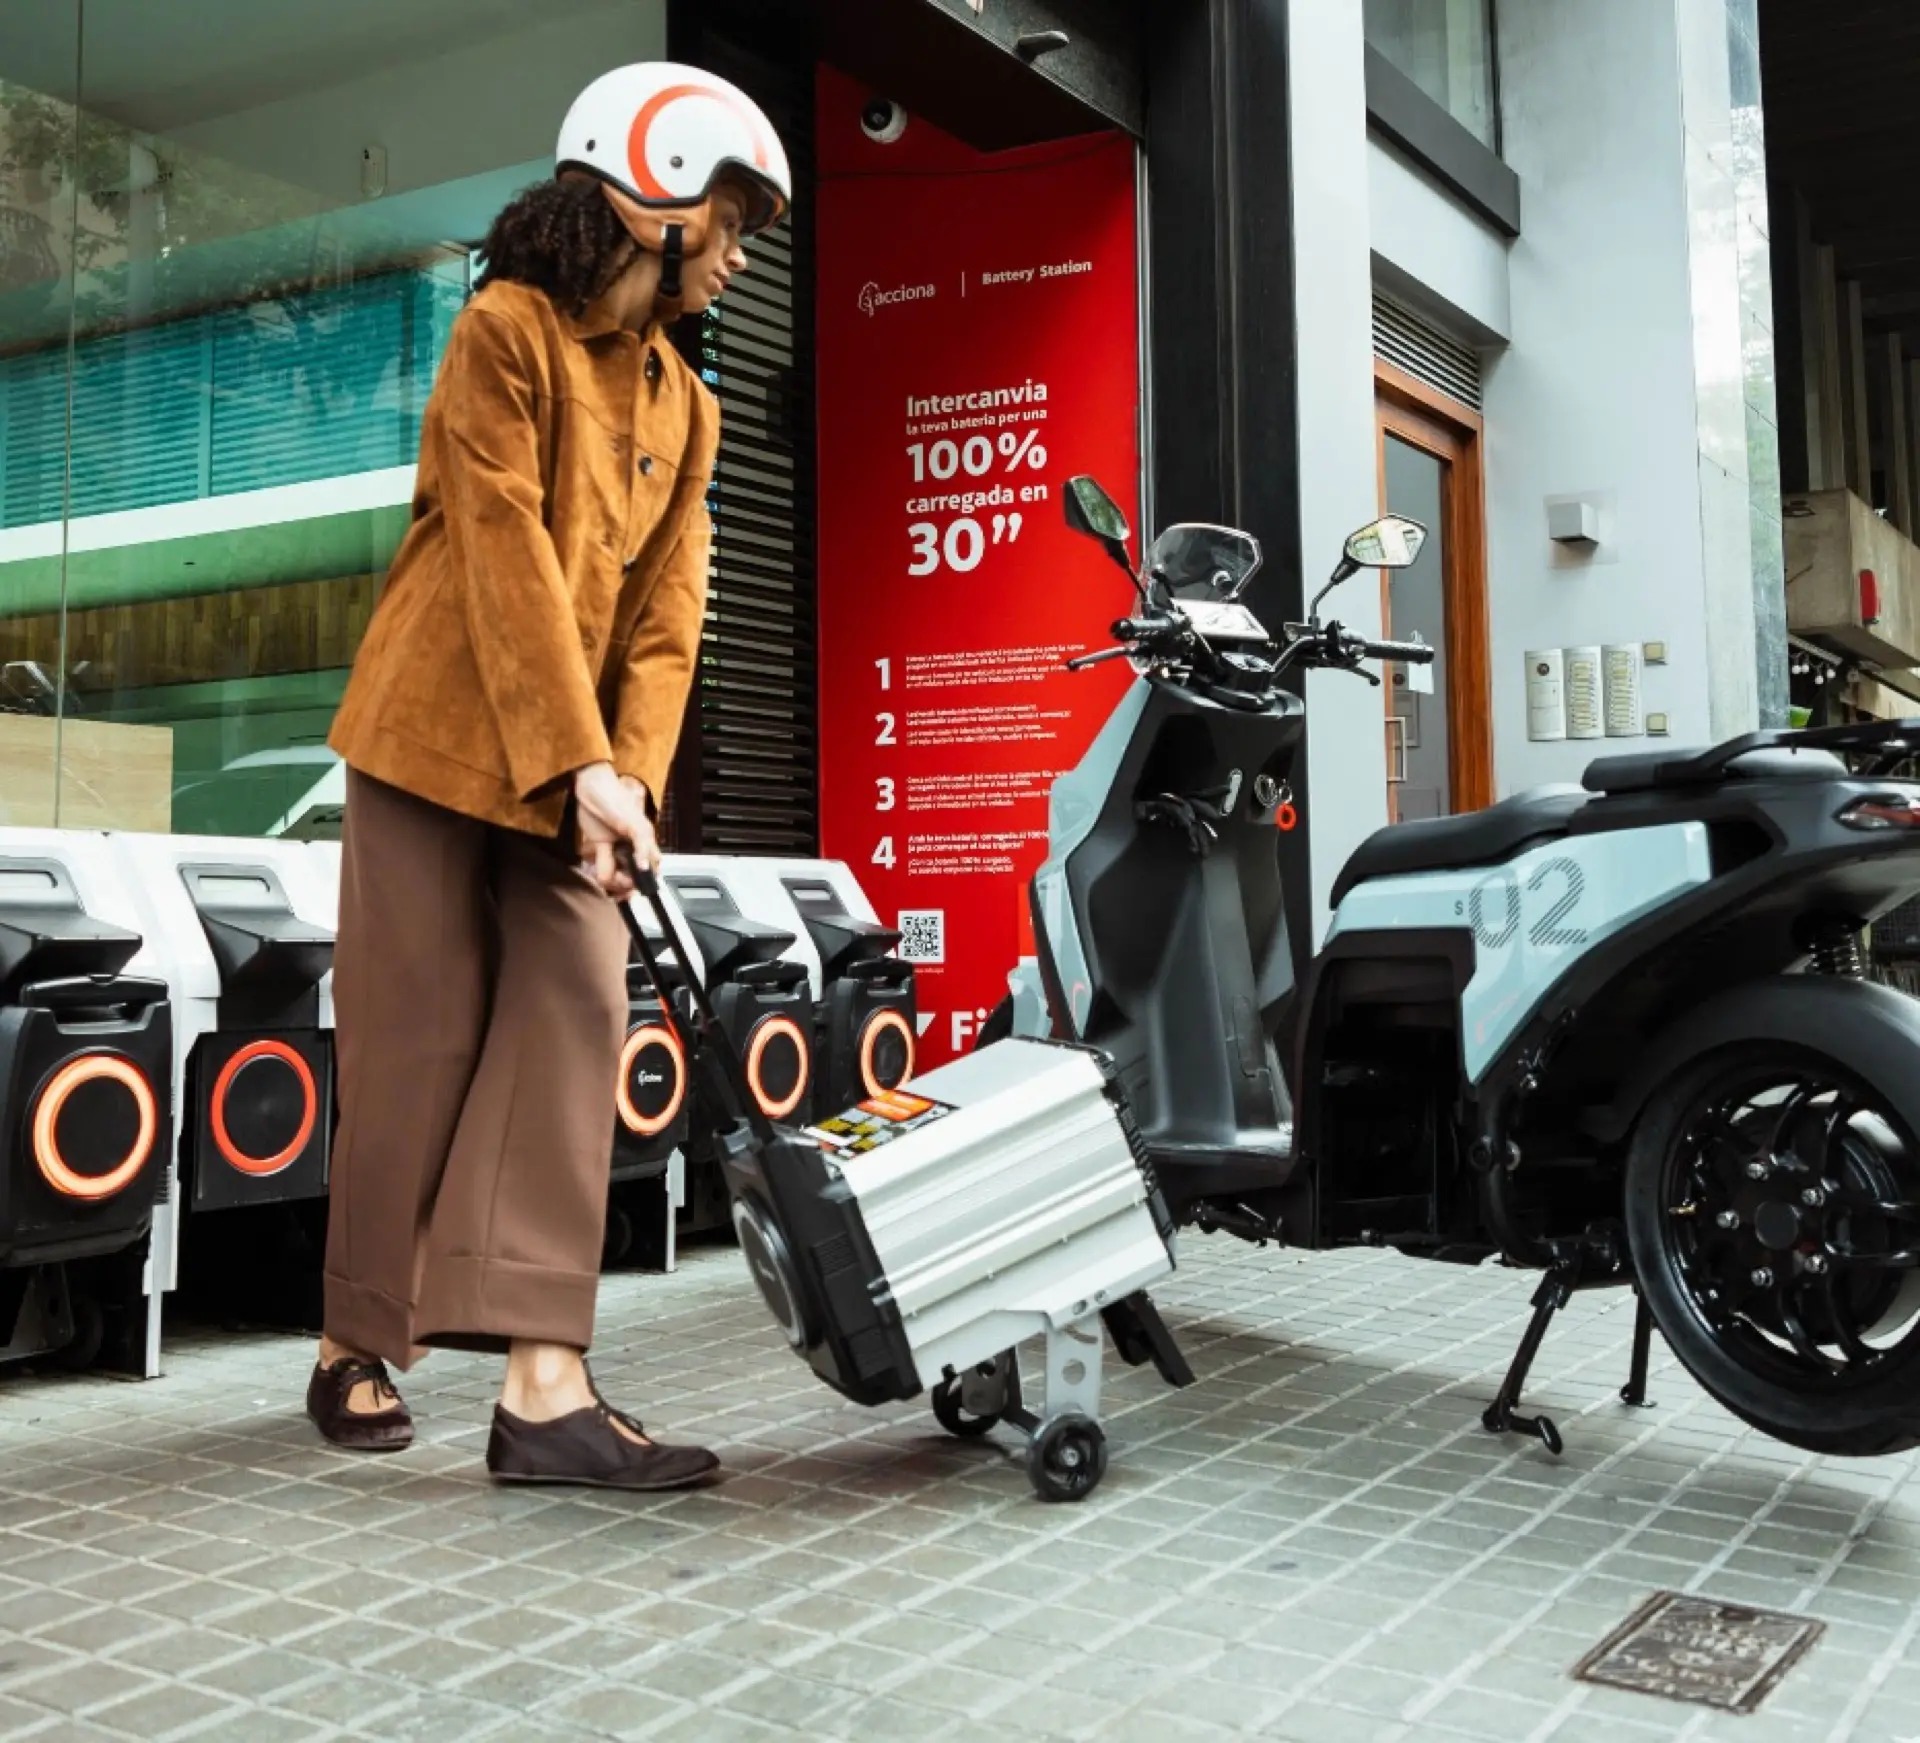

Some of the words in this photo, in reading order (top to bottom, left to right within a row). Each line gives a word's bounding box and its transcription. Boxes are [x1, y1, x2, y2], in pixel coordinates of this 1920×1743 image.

[982, 269, 1035, 285] Battery
[1040, 259, 1093, 278] Station
[875, 282, 936, 306] acciona
[907, 378, 1048, 417] Intercanvia
[906, 423, 918, 436] la
[920, 421, 948, 434] teva
[951, 413, 996, 430] bateria
[998, 411, 1020, 427] per
[1023, 409, 1048, 421] una
[906, 429, 1048, 483] 100%
[906, 483, 1014, 515] carregada
[1020, 482, 1048, 502] en
[874, 657, 891, 691] 1
[874, 712, 897, 745] 2
[874, 776, 896, 812] 3
[870, 835, 897, 870] 4
